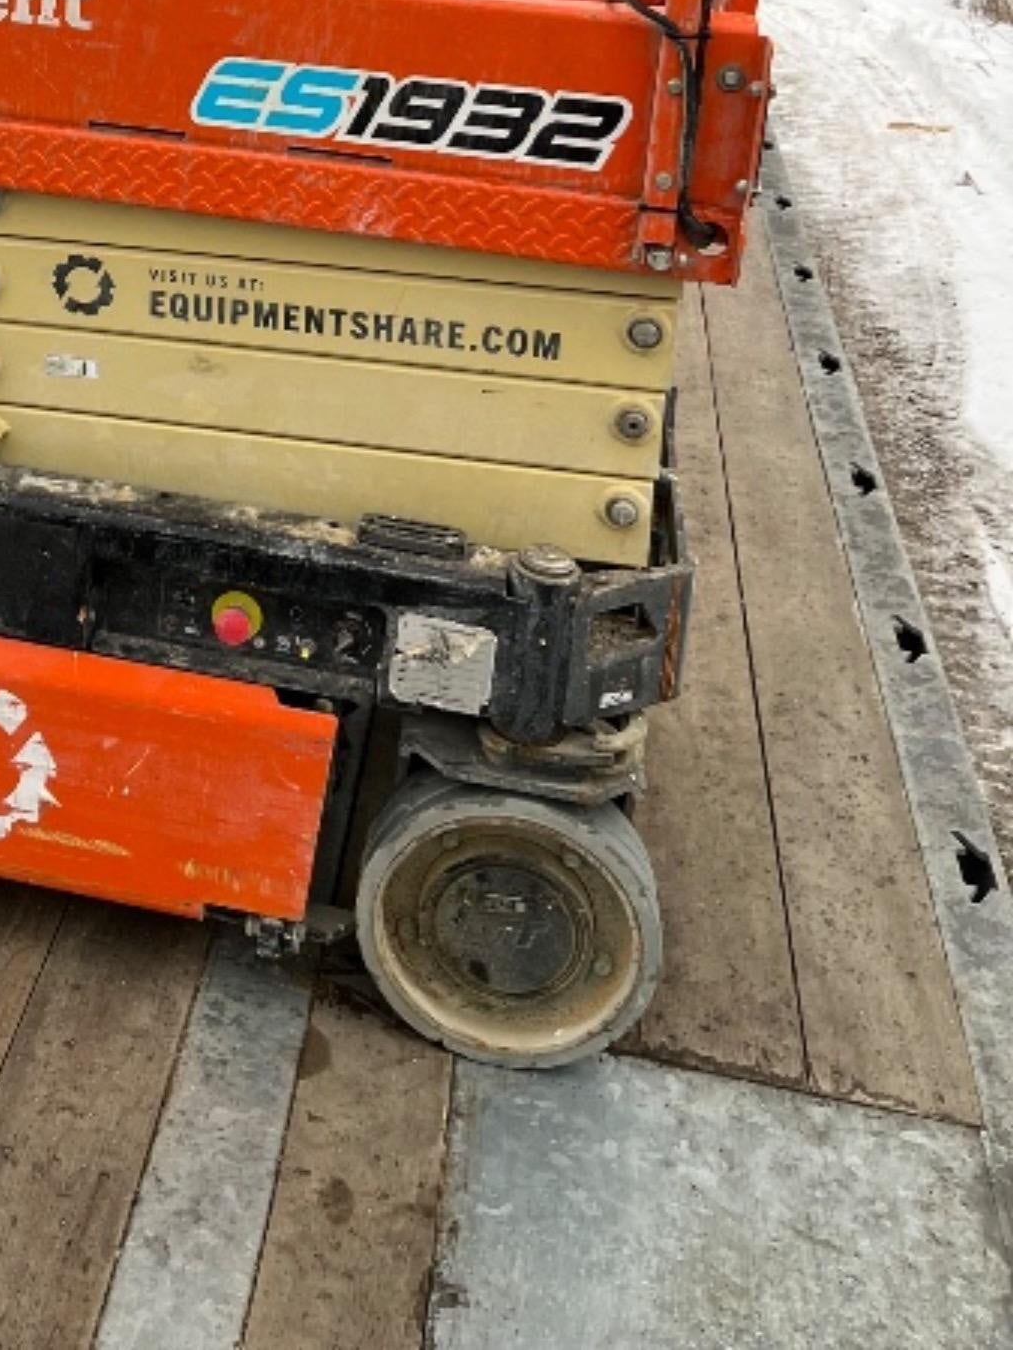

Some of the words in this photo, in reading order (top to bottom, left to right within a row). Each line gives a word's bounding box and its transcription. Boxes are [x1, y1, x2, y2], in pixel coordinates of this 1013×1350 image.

[192, 58, 628, 168] ES1932
[149, 268, 197, 286] VISIT
[205, 273, 229, 289] US
[150, 289, 562, 361] EQUIPMENTSHARE.COM
